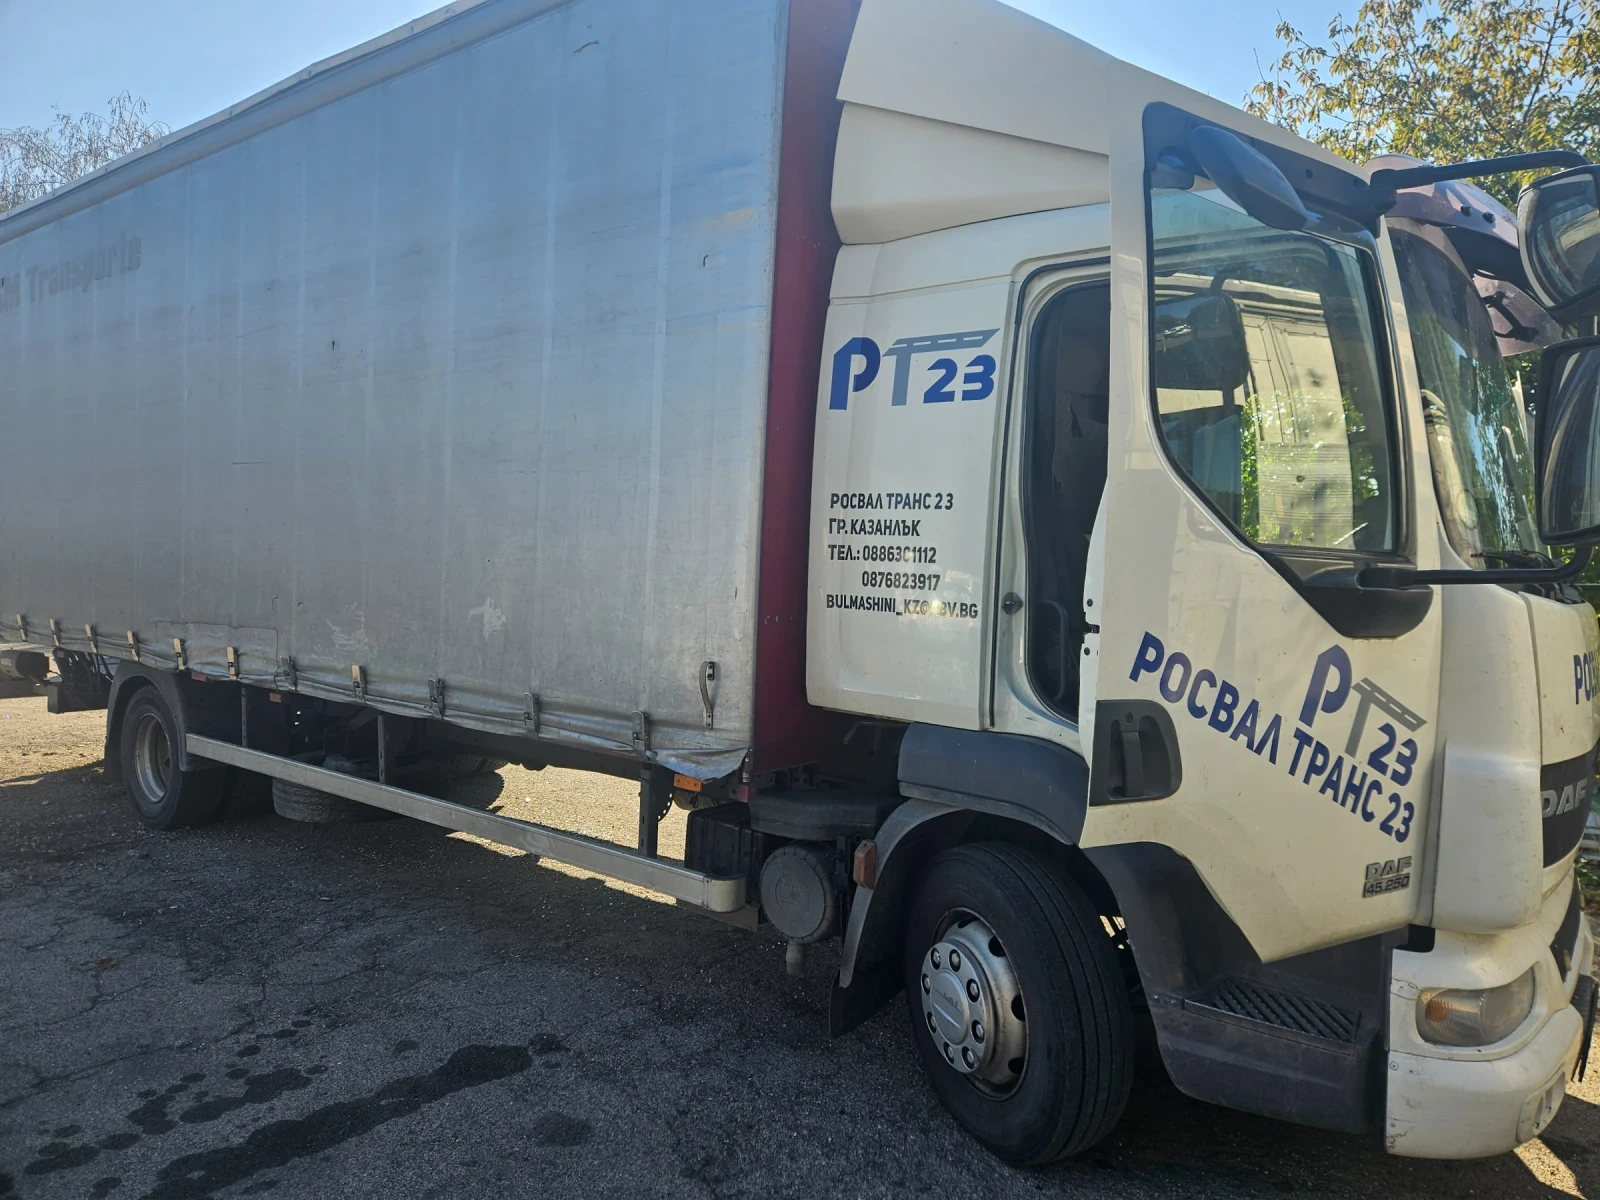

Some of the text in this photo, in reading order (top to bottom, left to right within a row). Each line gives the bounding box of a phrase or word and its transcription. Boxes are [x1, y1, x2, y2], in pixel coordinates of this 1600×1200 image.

[830, 493, 954, 510] РОСВАЛ ТРАНС 23
[828, 545, 937, 563] ТЕЛ.: 0886301112
[862, 571, 941, 591] 0876823917
[826, 594, 978, 618] BULMASHINI_KZ@BV.BG
[1129, 631, 1415, 843] РОСВАЛ ТРАНС 23
[1541, 777, 1587, 818] DAF
[1365, 856, 1412, 881] DAF
[1366, 875, 1410, 895] 45.250
